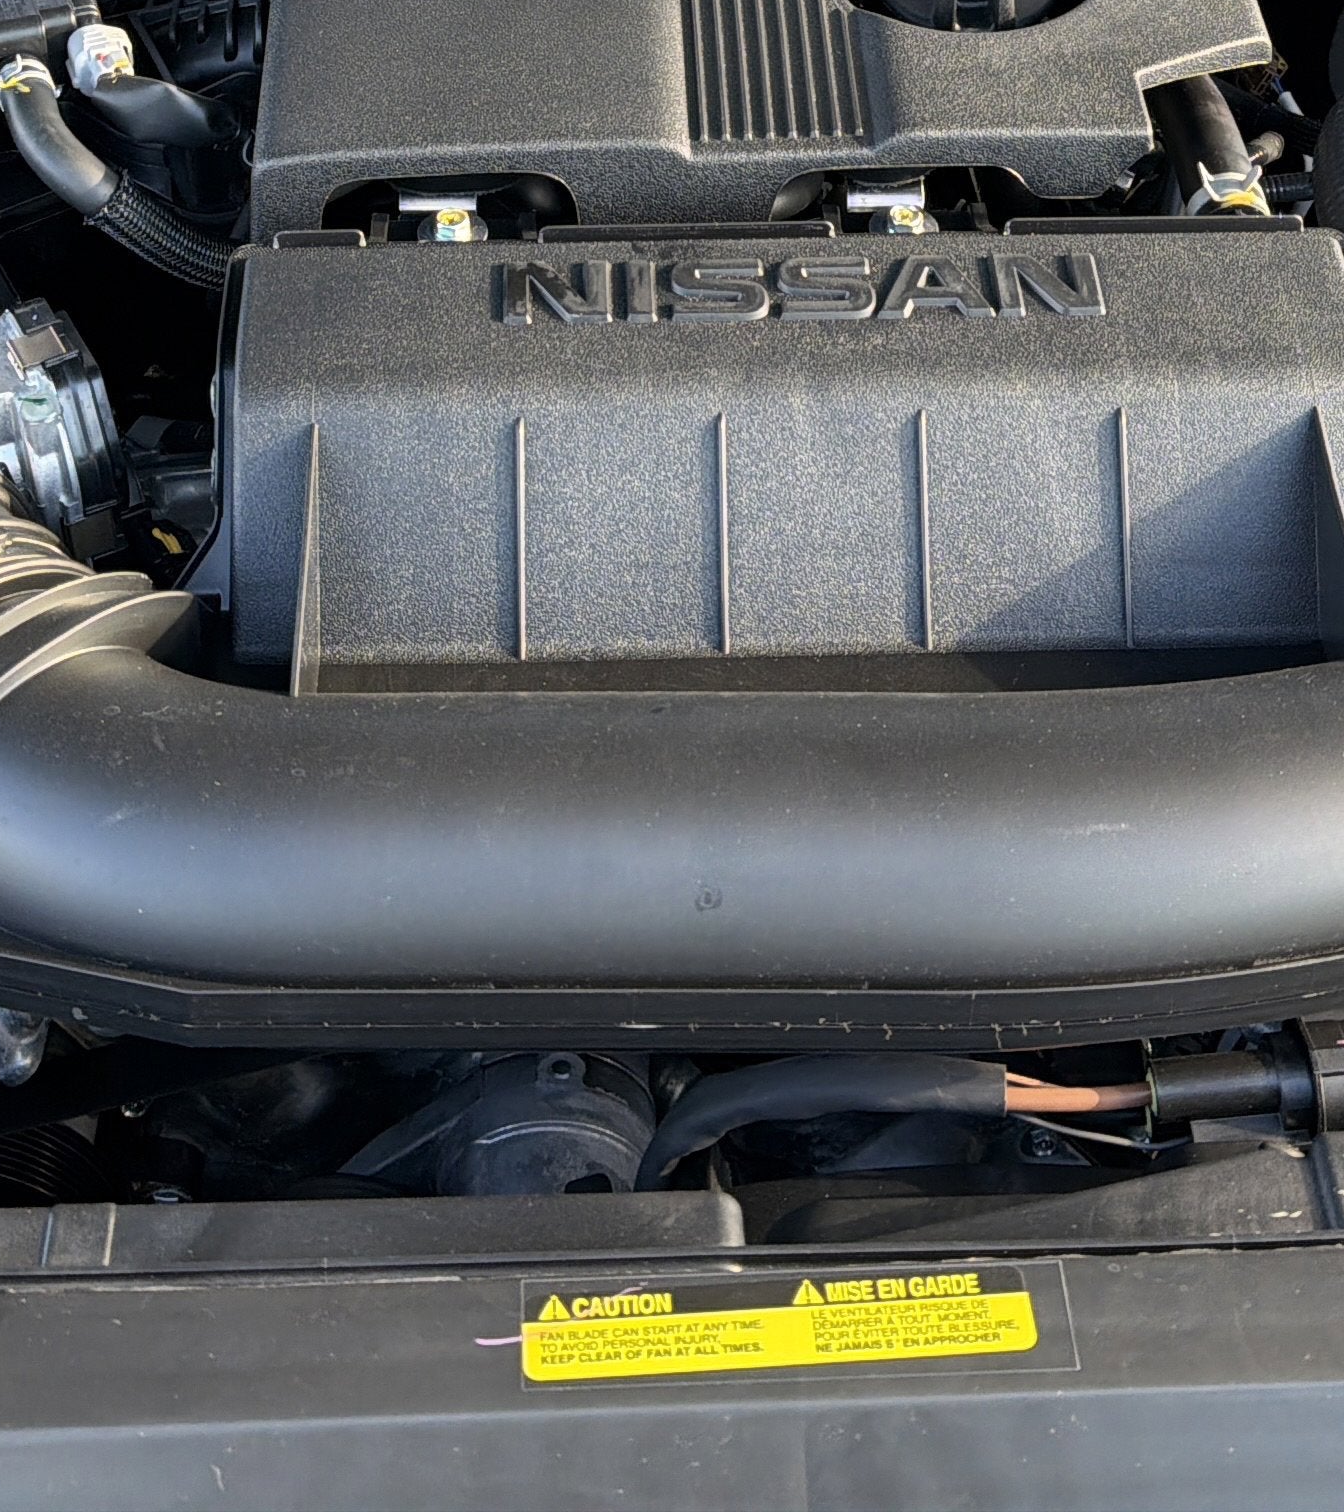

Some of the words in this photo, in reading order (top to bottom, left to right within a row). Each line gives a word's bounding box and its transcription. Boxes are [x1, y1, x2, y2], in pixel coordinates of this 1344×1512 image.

[497, 253, 1107, 324] NISSAN
[824, 1280, 875, 1303] MISE
[877, 1277, 907, 1300] EN
[909, 1272, 982, 1298] GARDE
[571, 1292, 673, 1319] CAUTION
[810, 1309, 827, 1320] LE
[829, 1303, 916, 1319] VENTILATEUR
[919, 1300, 968, 1313] RISQUE
[970, 1298, 989, 1310] DE
[899, 1313, 931, 1326] TOUT
[539, 1330, 565, 1342] FAN
[567, 1328, 609, 1341] BLADE
[612, 1326, 640, 1338] CAN
[642, 1324, 683, 1337] START
[685, 1322, 700, 1333] AT
[703, 1320, 728, 1333] ANY
[814, 1330, 850, 1343] POUR
[903, 1323, 944, 1336] TOUTE
[815, 1342, 833, 1353] NE
[836, 1339, 883, 1353] JAMAIS
[923, 1331, 1002, 1346] APPROCHER
[540, 1342, 559, 1354] TO
[560, 1340, 599, 1353] AVOID
[602, 1335, 671, 1350] PERSONAL
[540, 1353, 576, 1365] KEEP
[578, 1350, 622, 1363] CLEAR
[625, 1348, 643, 1361] OF
[646, 1347, 672, 1359] FAN
[675, 1346, 690, 1357] AT
[694, 1344, 720, 1356] ALL
